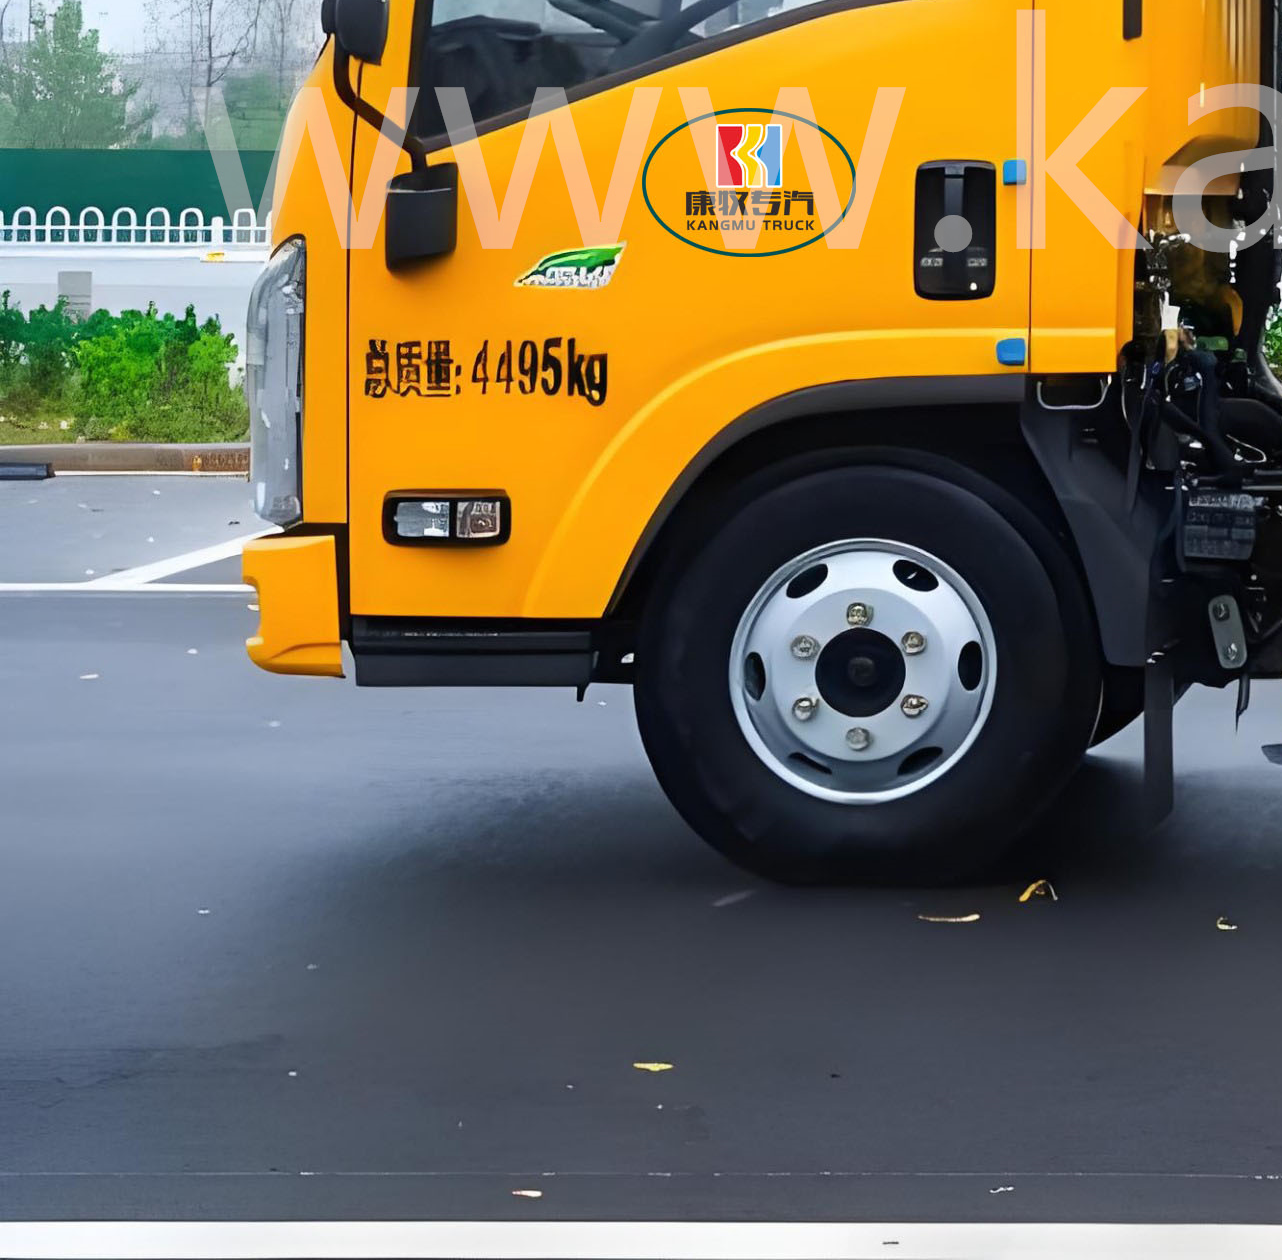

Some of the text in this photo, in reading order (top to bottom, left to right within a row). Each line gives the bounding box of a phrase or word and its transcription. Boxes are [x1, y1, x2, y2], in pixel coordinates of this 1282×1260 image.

[685, 190, 815, 216] 康牧专汽
[686, 219, 815, 231] KANGMU TRUCK
